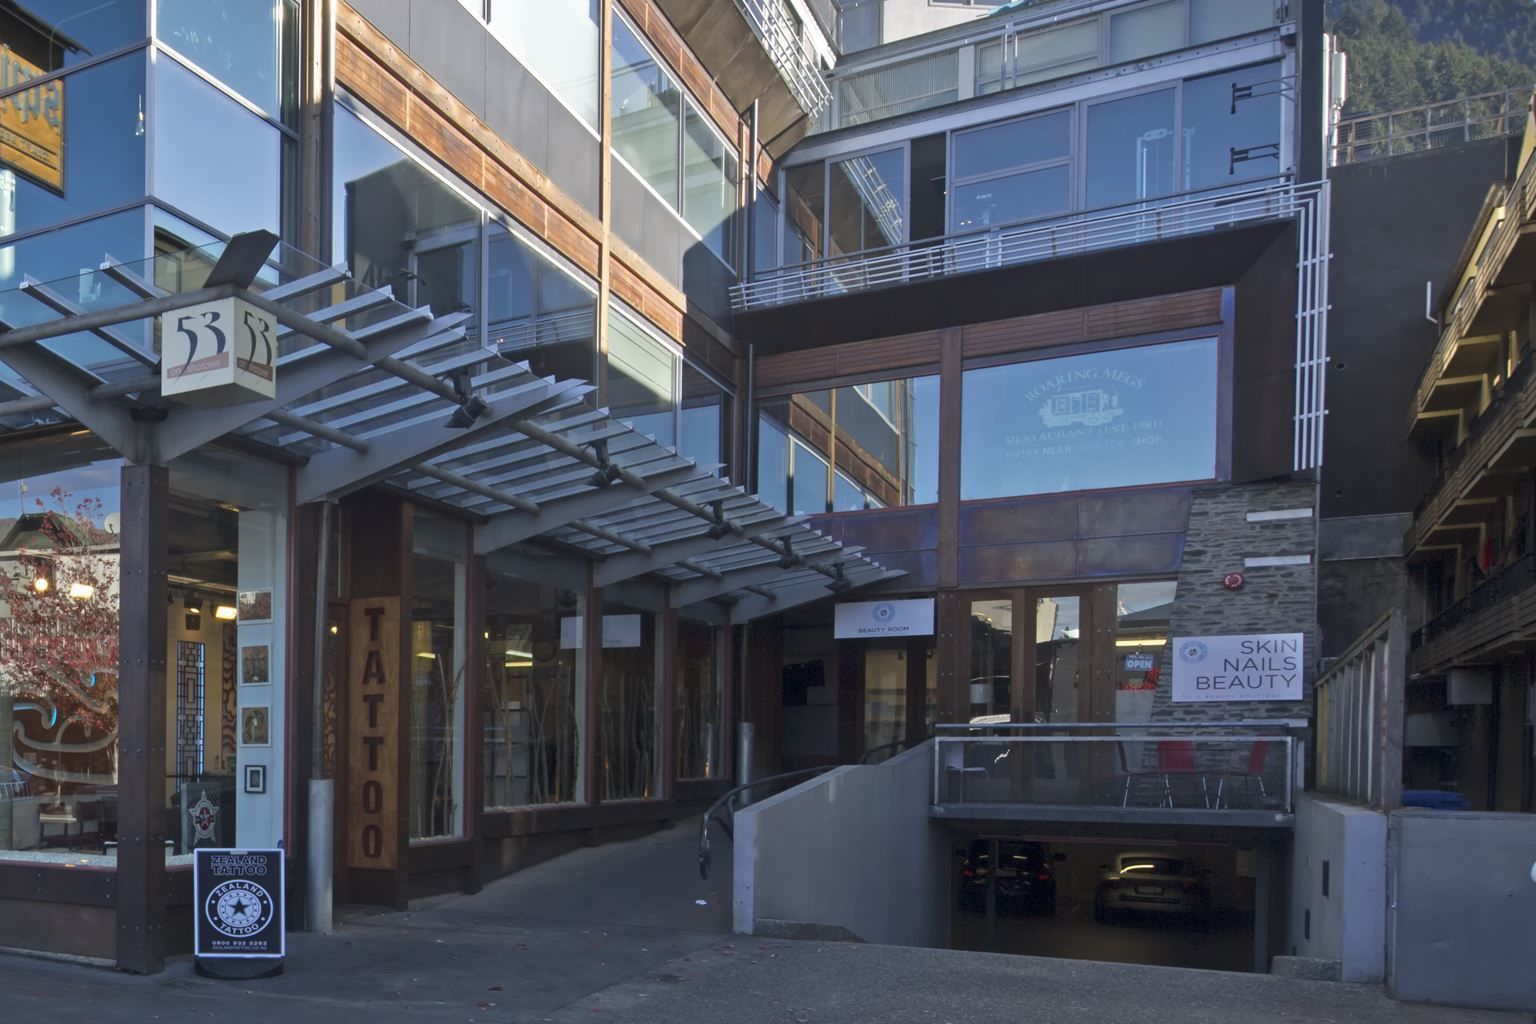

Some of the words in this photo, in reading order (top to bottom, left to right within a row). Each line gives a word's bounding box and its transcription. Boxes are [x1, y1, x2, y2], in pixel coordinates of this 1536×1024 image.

[173, 311, 226, 380] 53
[244, 310, 273, 370] 53
[1024, 367, 1098, 403] ROARING
[1240, 639, 1297, 655] SKIN
[1126, 659, 1152, 669] OPEN
[1224, 656, 1297, 673] NAILS
[1196, 673, 1297, 690] BEAUTY
[361, 607, 387, 858] TATTOO
[210, 855, 268, 865] ZEALAND
[212, 865, 267, 876] TATTOO
[215, 882, 264, 898] ZEALAND
[219, 923, 260, 935] TATTOO
